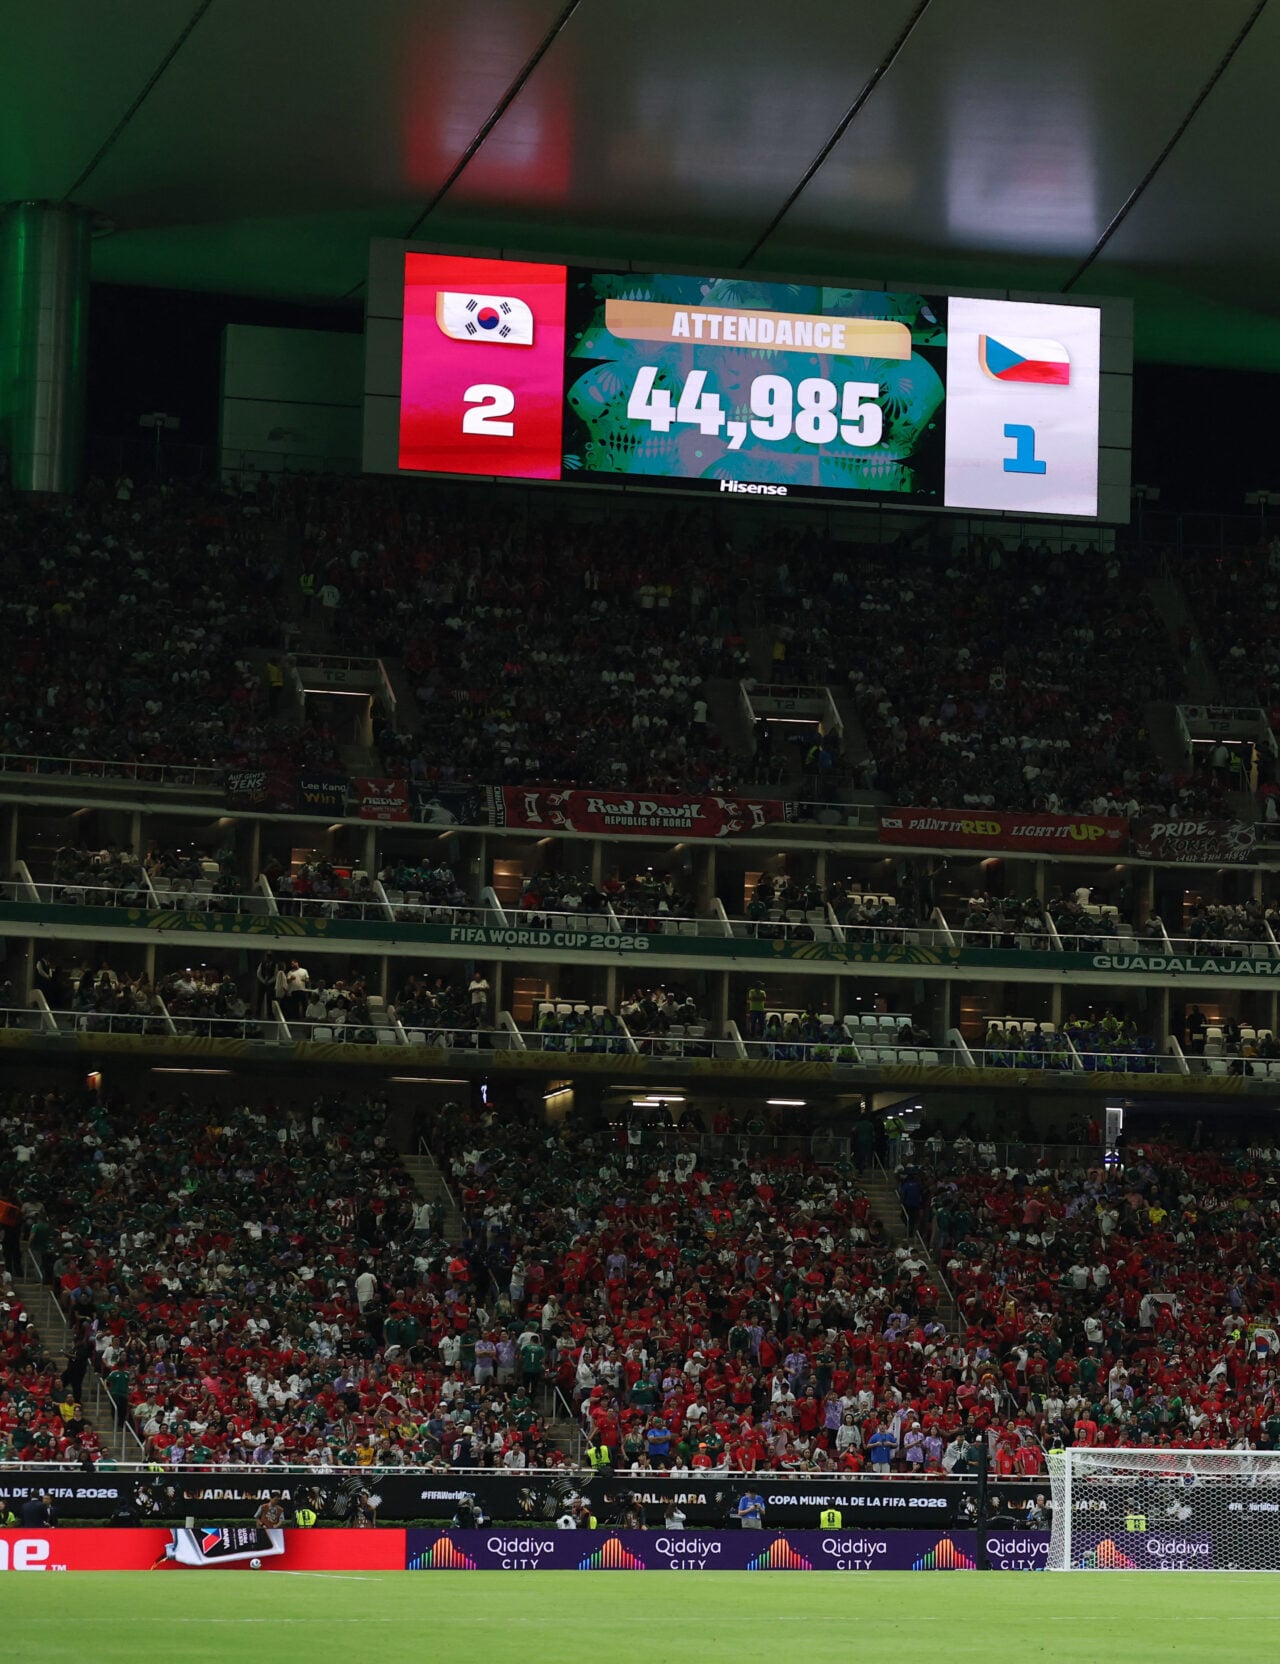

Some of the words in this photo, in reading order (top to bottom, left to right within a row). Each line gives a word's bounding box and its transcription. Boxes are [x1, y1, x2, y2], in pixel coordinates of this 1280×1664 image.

[671, 311, 846, 350] ATTENDANCE
[462, 384, 515, 437] 2
[627, 366, 883, 449] 44,985
[1003, 424, 1047, 474] 1
[720, 480, 788, 496] Hisense
[301, 781, 319, 790] Lee
[323, 784, 346, 793] Kang
[587, 798, 634, 815] Red
[640, 801, 706, 819] Devil
[604, 815, 649, 827] REPUBLIC
[650, 817, 662, 827] OF
[664, 818, 692, 829] KOREA
[908, 818, 948, 831] PAINT
[948, 821, 963, 832] IT
[960, 819, 1001, 835] RED
[1011, 825, 1053, 837] LIGHT
[1055, 826, 1070, 838] IT
[1069, 824, 1105, 841] UP
[1151, 821, 1208, 840] PRIDE
[450, 928, 487, 943] FIFA
[489, 930, 550, 946] WORLD
[553, 933, 587, 947] CUP
[590, 935, 650, 950] 2026
[13, 1488, 28, 1498] DE
[76, 1489, 118, 1498] 2026
[768, 1496, 798, 1505] COPA
[800, 1496, 848, 1506] MUNDAL
[851, 1497, 864, 1506] DE
[866, 1497, 881, 1507] LA
[883, 1498, 906, 1507] FIFA
[909, 1498, 947, 1508] 2026
[487, 1537, 554, 1555] Qiddiya
[655, 1537, 722, 1556] Qiddiya
[822, 1538, 887, 1556] Qiddiya
[986, 1538, 1049, 1556] Qiddiya
[1147, 1539, 1209, 1557] Qiddiya
[502, 1559, 539, 1570] CITY
[670, 1560, 706, 1570] CITY
[837, 1560, 872, 1570] CITY
[1001, 1560, 1035, 1570] CITY
